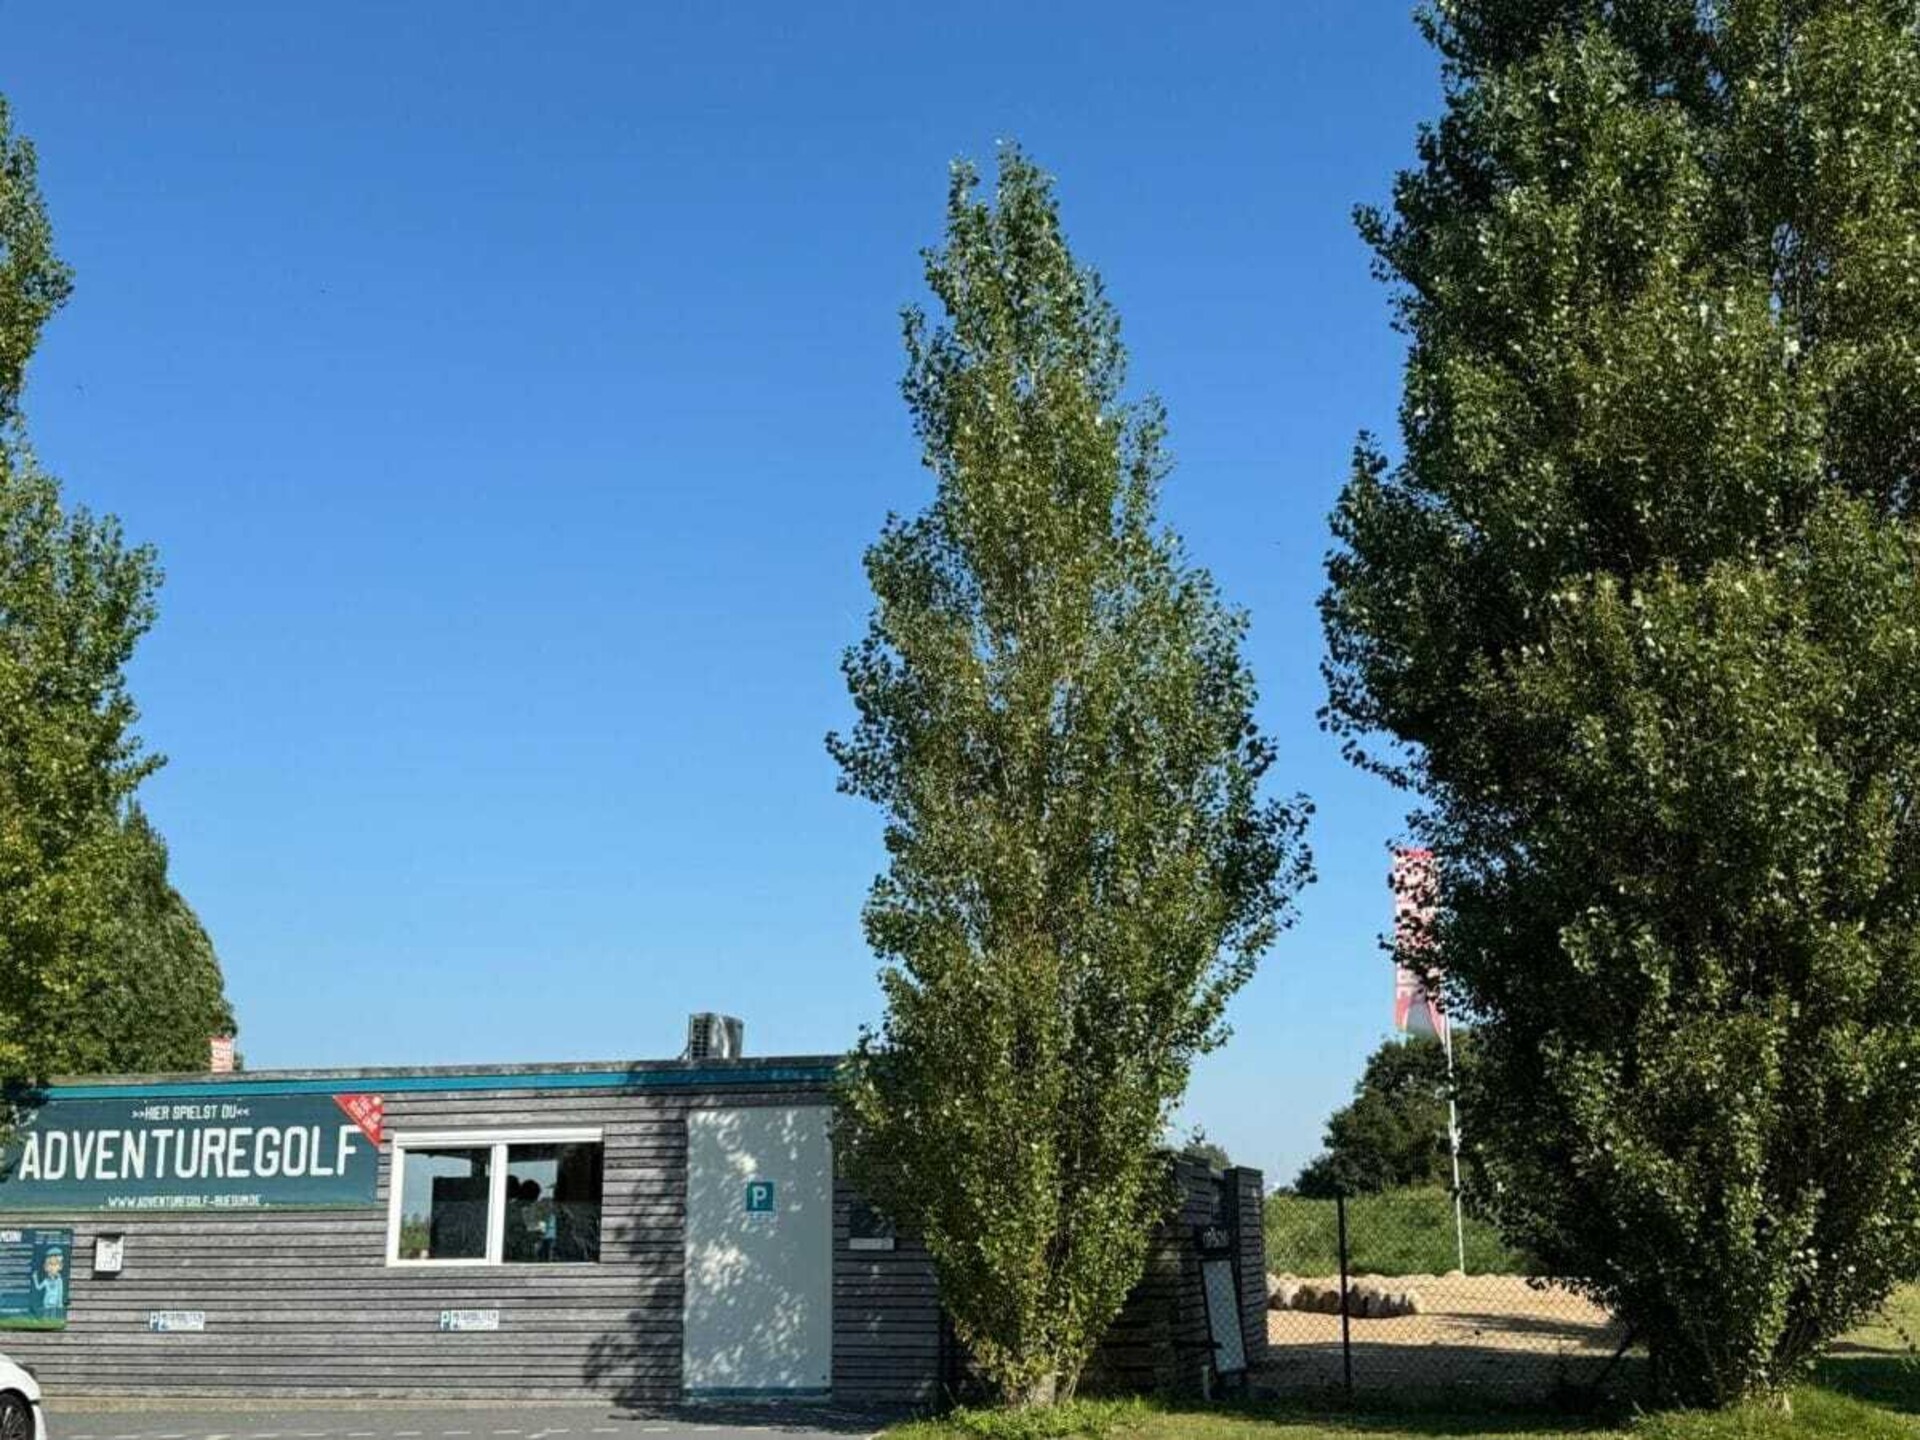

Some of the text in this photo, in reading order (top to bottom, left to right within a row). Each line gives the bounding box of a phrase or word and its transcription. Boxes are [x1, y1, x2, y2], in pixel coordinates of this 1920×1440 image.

[173, 1104, 218, 1119] SPIELST
[19, 1125, 362, 1181] ADVENTUREGOLF
[752, 1186, 767, 1208] P
